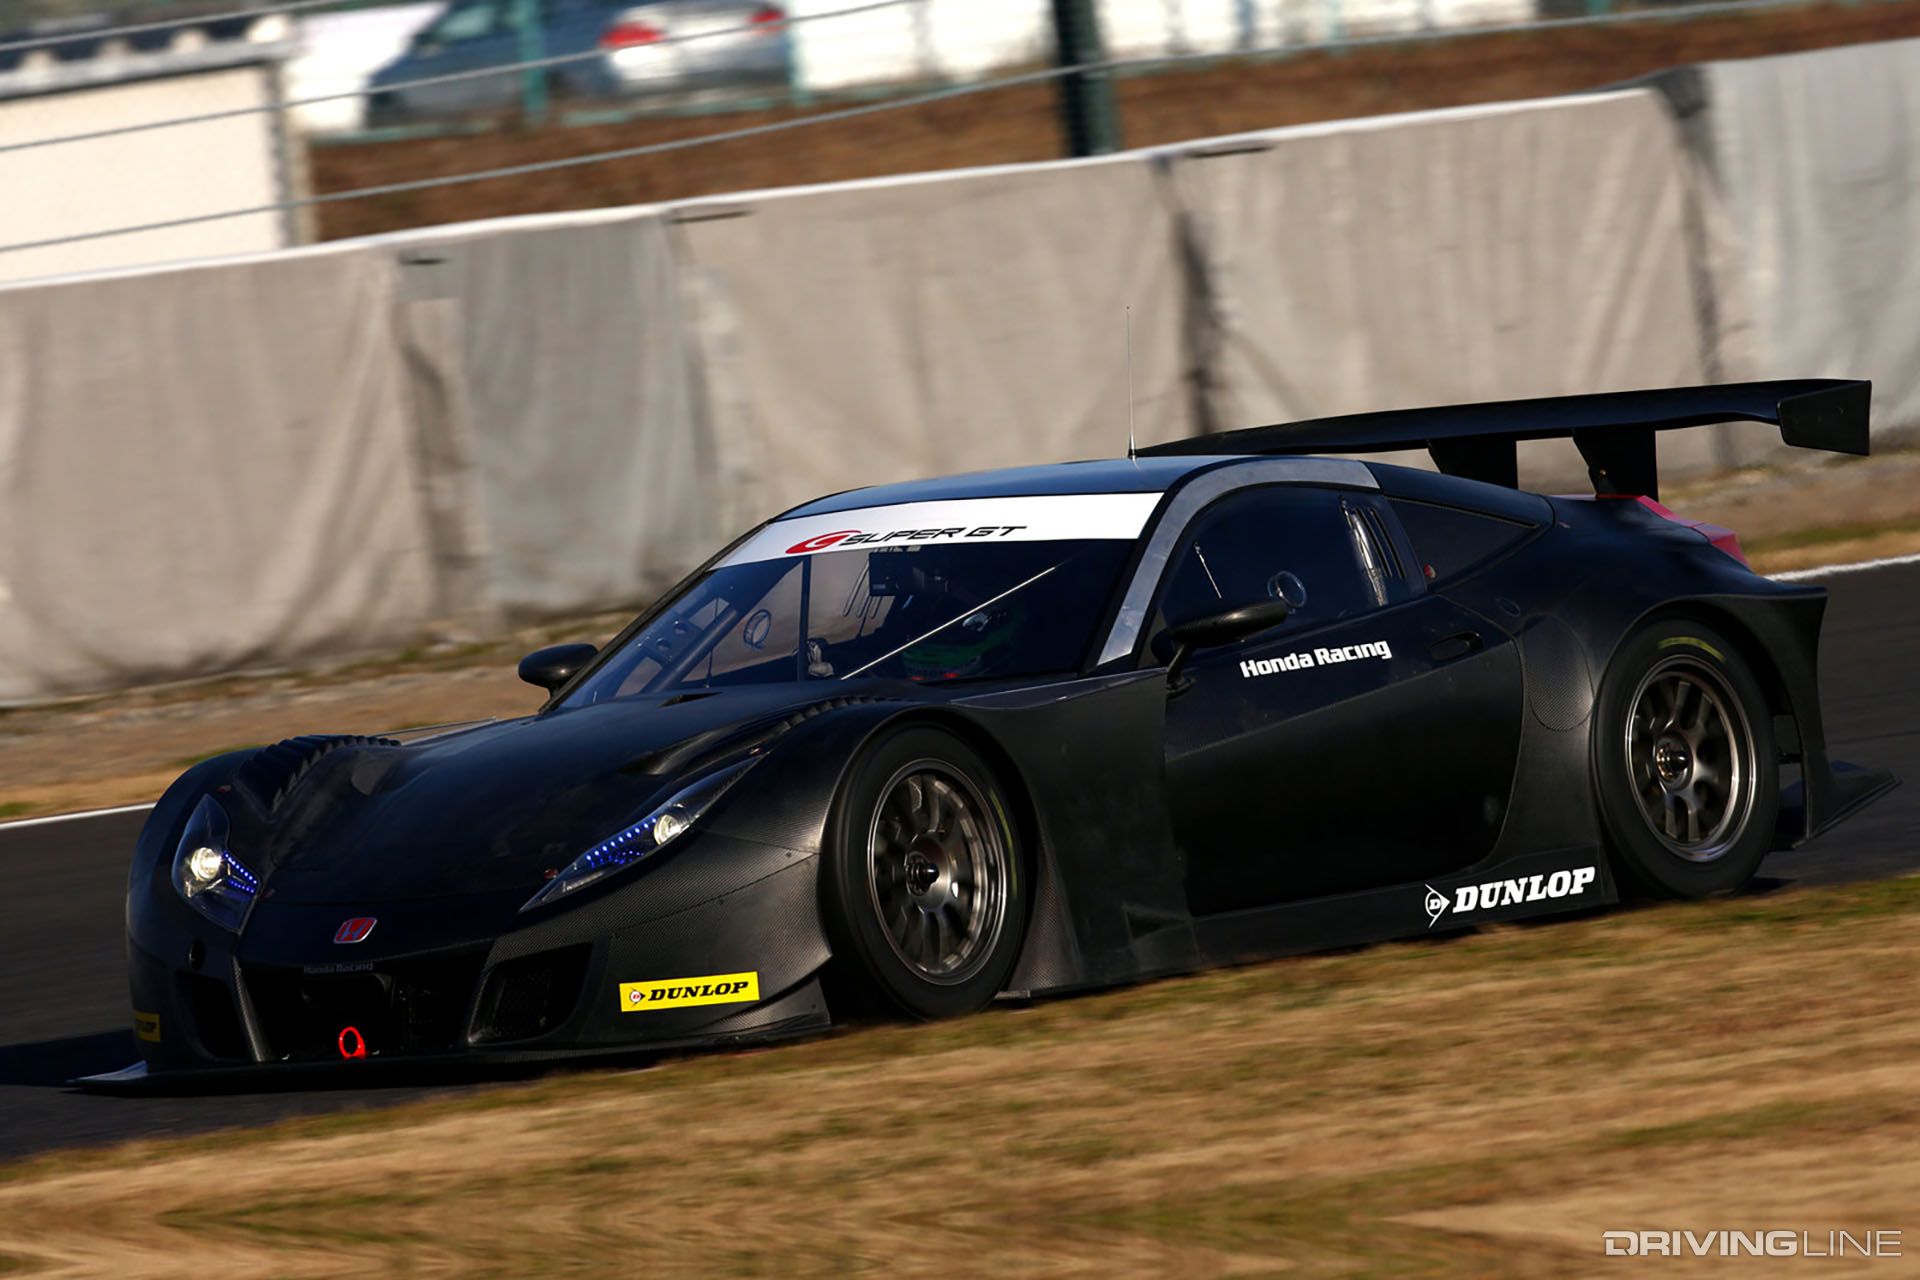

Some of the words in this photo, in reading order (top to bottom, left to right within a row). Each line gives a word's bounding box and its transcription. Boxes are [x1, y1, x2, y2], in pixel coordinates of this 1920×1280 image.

[839, 526, 968, 547] SUPER
[964, 525, 1028, 538] GT
[1239, 652, 1316, 679] Honda
[1313, 639, 1393, 666] Racing
[1452, 866, 1596, 914] DUNLOP
[647, 981, 749, 1002] DUNLOP
